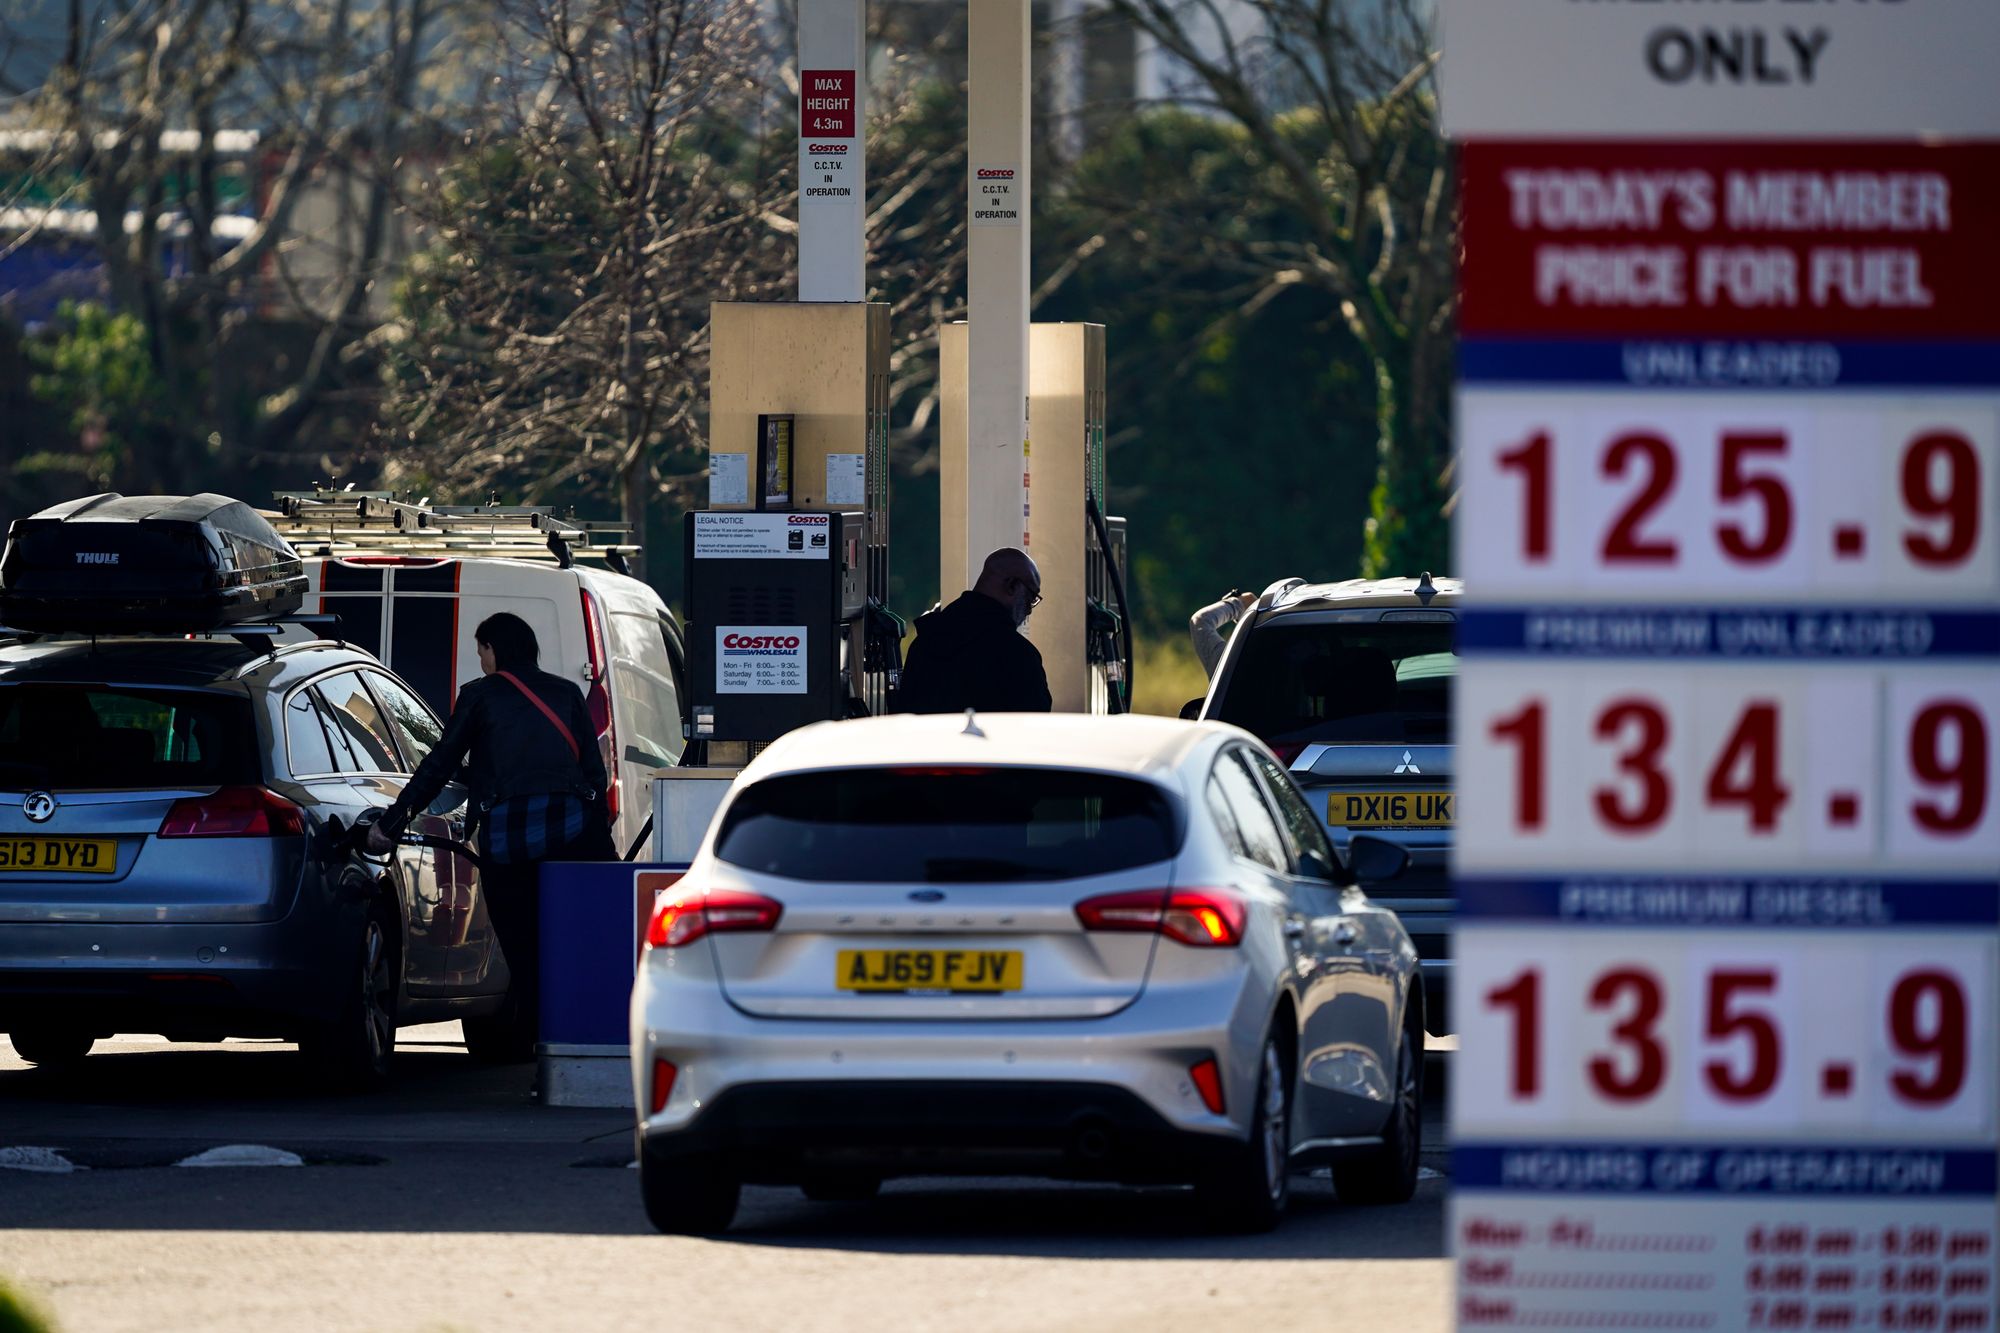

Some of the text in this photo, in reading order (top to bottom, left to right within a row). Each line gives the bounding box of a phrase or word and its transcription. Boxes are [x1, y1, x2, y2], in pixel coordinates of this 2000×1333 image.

[1645, 26, 1829, 84] ONLY
[814, 79, 842, 91] MAX
[807, 98, 850, 110] HEIGHT
[813, 117, 843, 130] 4.3m
[814, 161, 843, 170] C.C.T.V.
[824, 174, 833, 183] IN
[806, 187, 851, 197] OPERATION
[982, 185, 1010, 194] C.C.T.V.
[991, 198, 1000, 206] IN
[1505, 167, 1952, 232] TODAY'S MEMBER
[975, 210, 1017, 219] OPERATION
[1535, 245, 1934, 308] PRICE FOR FUEL
[1622, 343, 1840, 385] UNLEADED
[1496, 424, 1982, 570] 125.9
[697, 517, 744, 525] LEGAL NOTICE
[75, 552, 120, 564] THULE
[723, 633, 800, 649] COSTCO
[1525, 612, 1932, 655] PREMIUM UNLEADED
[723, 670, 752, 679] Saturday
[723, 679, 748, 687] Sunday
[1488, 693, 1990, 838] 134.9
[1345, 794, 1457, 821] DX16 UK
[43, 841, 99, 868] DYD
[1560, 879, 1889, 923] PREMIUM DIESEL
[850, 952, 1008, 982] AJ69 FJV
[1484, 963, 1970, 1108] 135.9
[1502, 1150, 1943, 1192] HOURS OF OPERATION
